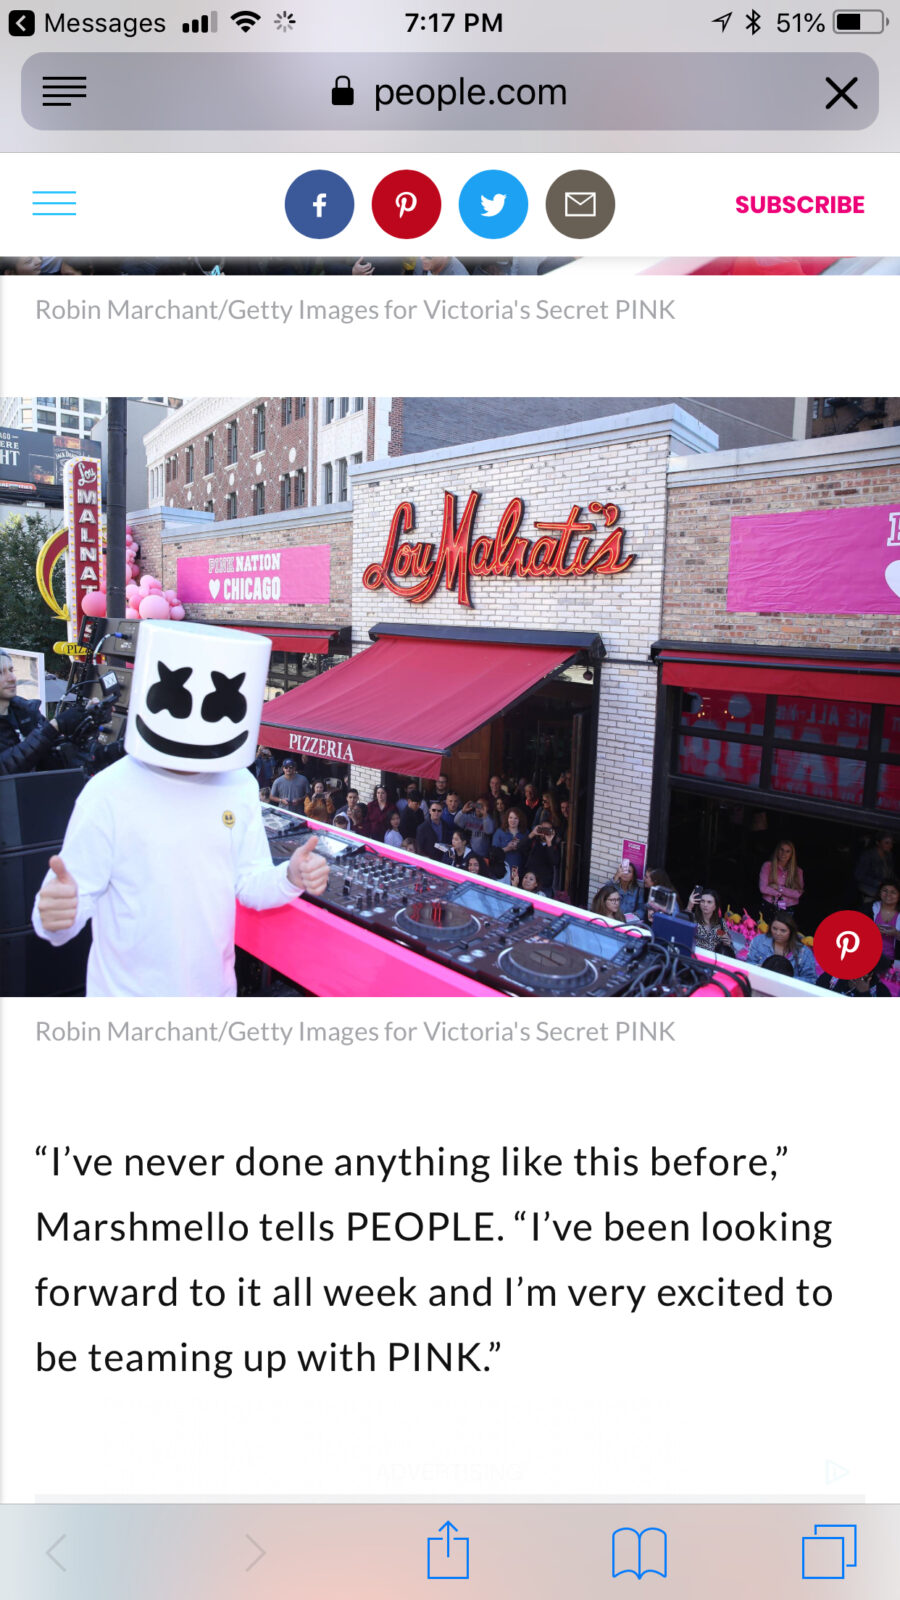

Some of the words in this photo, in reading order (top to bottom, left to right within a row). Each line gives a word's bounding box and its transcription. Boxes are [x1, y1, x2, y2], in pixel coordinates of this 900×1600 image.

[44, 12, 166, 38] Messages
[404, 12, 456, 33] 7:17
[464, 12, 503, 33] PM
[776, 12, 826, 34] 51%
[375, 76, 567, 112] people.com
[735, 195, 865, 215] SUBSCRIBE
[36, 299, 101, 319] Robin
[108, 299, 293, 323] Marchant/Getty
[299, 299, 379, 324] Images
[383, 299, 418, 319] for
[423, 299, 531, 319] Victoria's
[536, 299, 609, 319] Secret
[616, 299, 676, 319] PINK
[78, 462, 97, 487] Lou
[362, 501, 437, 598] Lou
[410, 489, 637, 609] Malnati's
[235, 553, 281, 572] NATION
[223, 577, 281, 601] CHICAGO
[288, 733, 355, 762] PIZZERIA
[36, 1021, 101, 1041] Robin
[108, 1021, 293, 1045] Marchant/Getty
[299, 1021, 379, 1046] Images
[383, 1021, 418, 1041] for
[423, 1021, 531, 1041] Victoria's
[536, 1021, 609, 1041] Secret
[616, 1021, 676, 1041] PINK
[35, 1144, 113, 1177] “I’ve
[125, 1154, 225, 1177] never
[235, 1145, 324, 1177] done
[334, 1145, 491, 1184] anything
[502, 1145, 563, 1177] like
[573, 1145, 639, 1177] this
[651, 1145, 788, 1182] before,”
[37, 1210, 249, 1242] Marshmello
[258, 1210, 335, 1242] tells
[347, 1211, 504, 1242] PEOPLE.
[514, 1210, 593, 1242] “I’ve
[605, 1210, 690, 1242] been
[702, 1210, 833, 1249] looking
[34, 1276, 177, 1307] forward
[189, 1278, 226, 1307] to
[238, 1276, 262, 1307] it
[272, 1276, 312, 1307] all
[322, 1276, 418, 1307] week
[428, 1276, 492, 1307] and
[506, 1275, 556, 1307] I’m
[567, 1284, 647, 1314] very
[657, 1276, 784, 1307] excited
[795, 1278, 833, 1307] to
[36, 1341, 77, 1373] be
[87, 1341, 234, 1379] teaming
[244, 1350, 287, 1379] up
[296, 1341, 376, 1373] with
[389, 1340, 501, 1373] PINK.”
